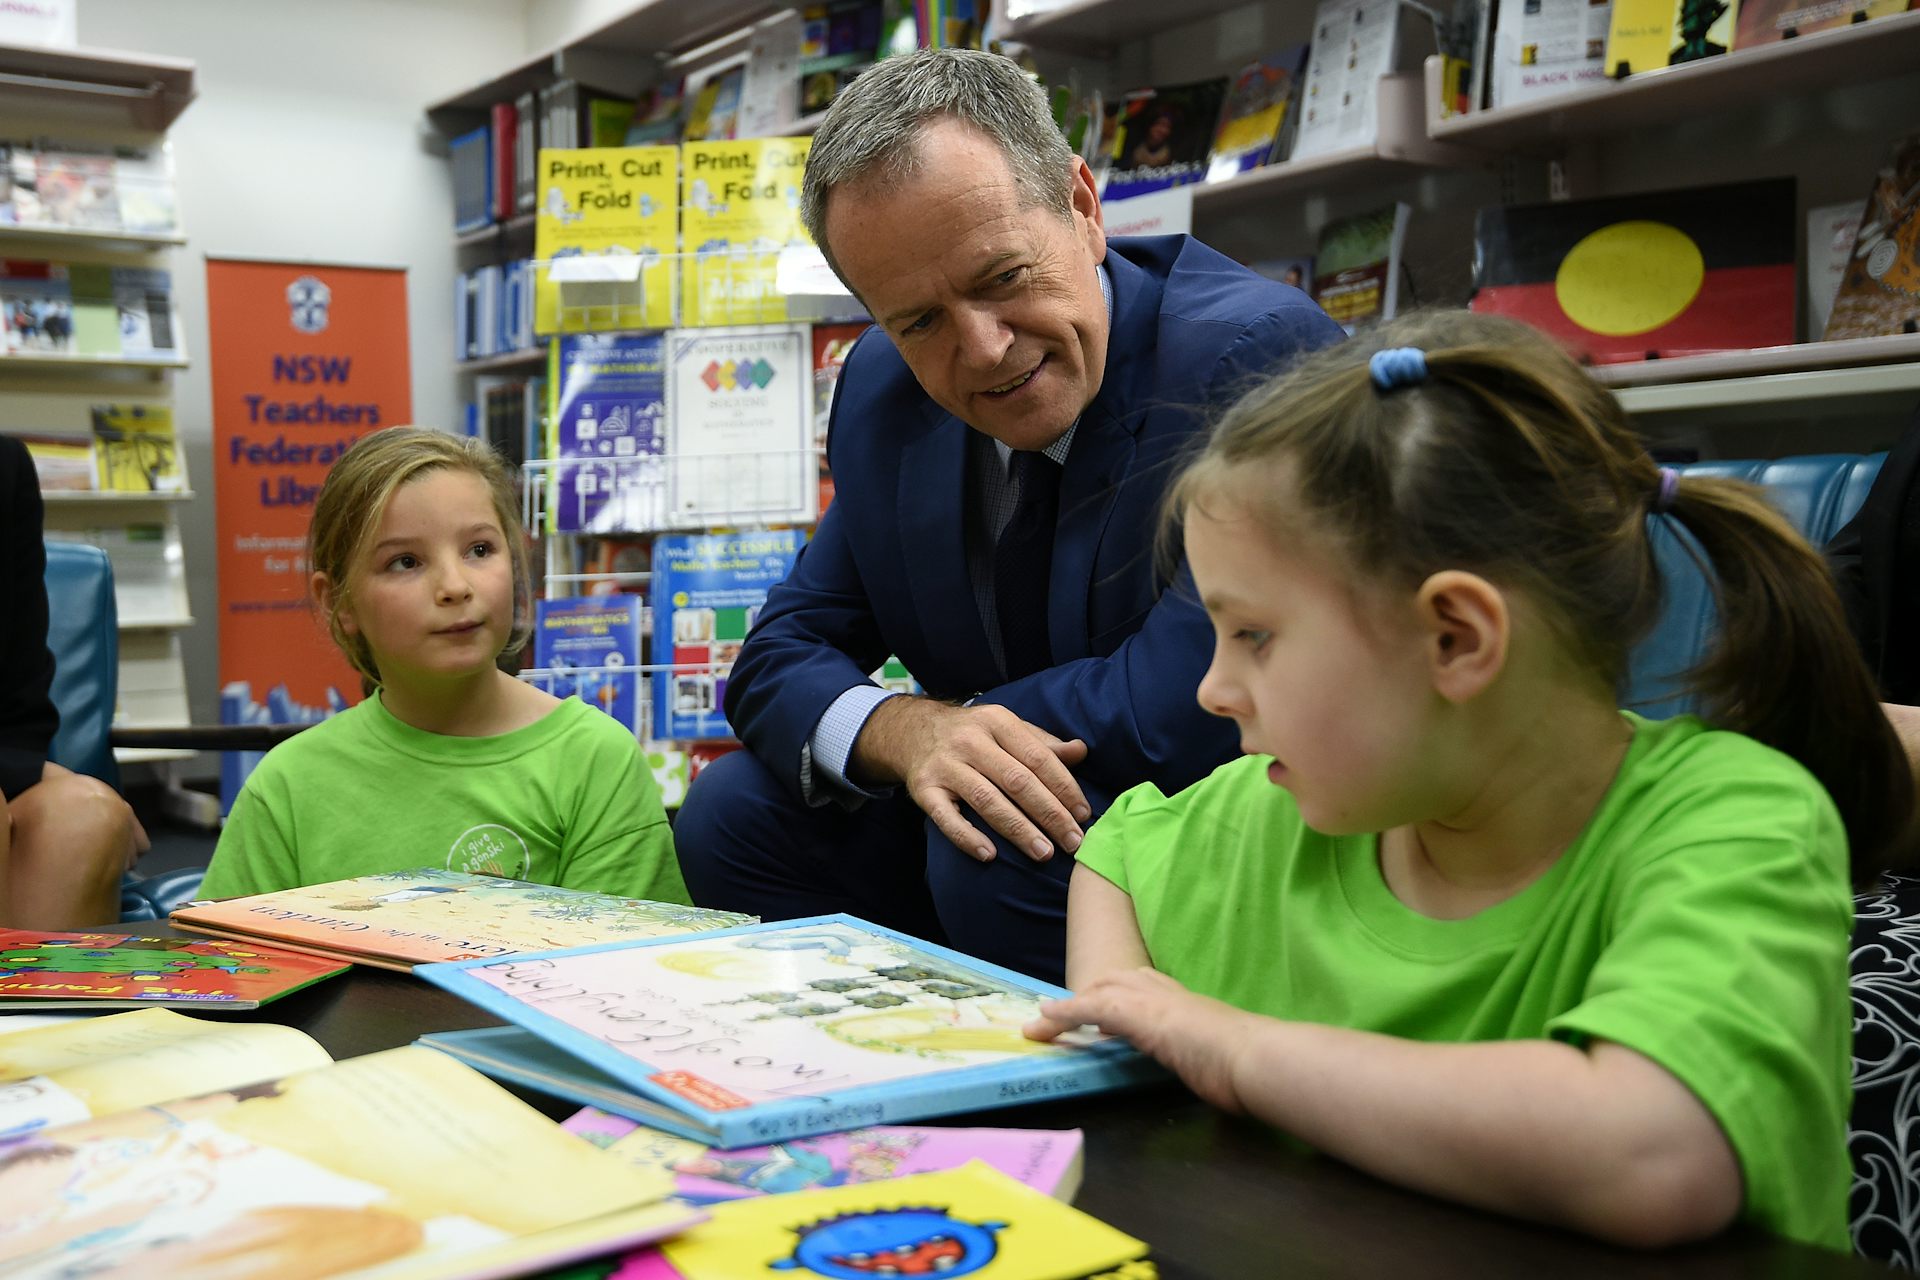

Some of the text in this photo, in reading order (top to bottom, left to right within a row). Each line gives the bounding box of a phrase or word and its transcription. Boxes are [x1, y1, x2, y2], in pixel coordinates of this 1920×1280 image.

[550, 159, 662, 179] Print, Cut
[693, 149, 807, 171] Print, Cut
[578, 191, 631, 210] Fold
[724, 182, 777, 200] Fold
[273, 354, 351, 383] NSW
[243, 394, 380, 424] Teachers
[230, 434, 358, 465] Federat
[260, 476, 320, 506] Libr
[468, 833, 490, 856] give
[249, 904, 370, 933] Garden
[381, 928, 416, 939] the
[420, 932, 442, 943] in
[0, 983, 123, 994] Fami
[482, 957, 693, 1044] Everything
[654, 1037, 742, 1053] of
[733, 1055, 851, 1104] Two
